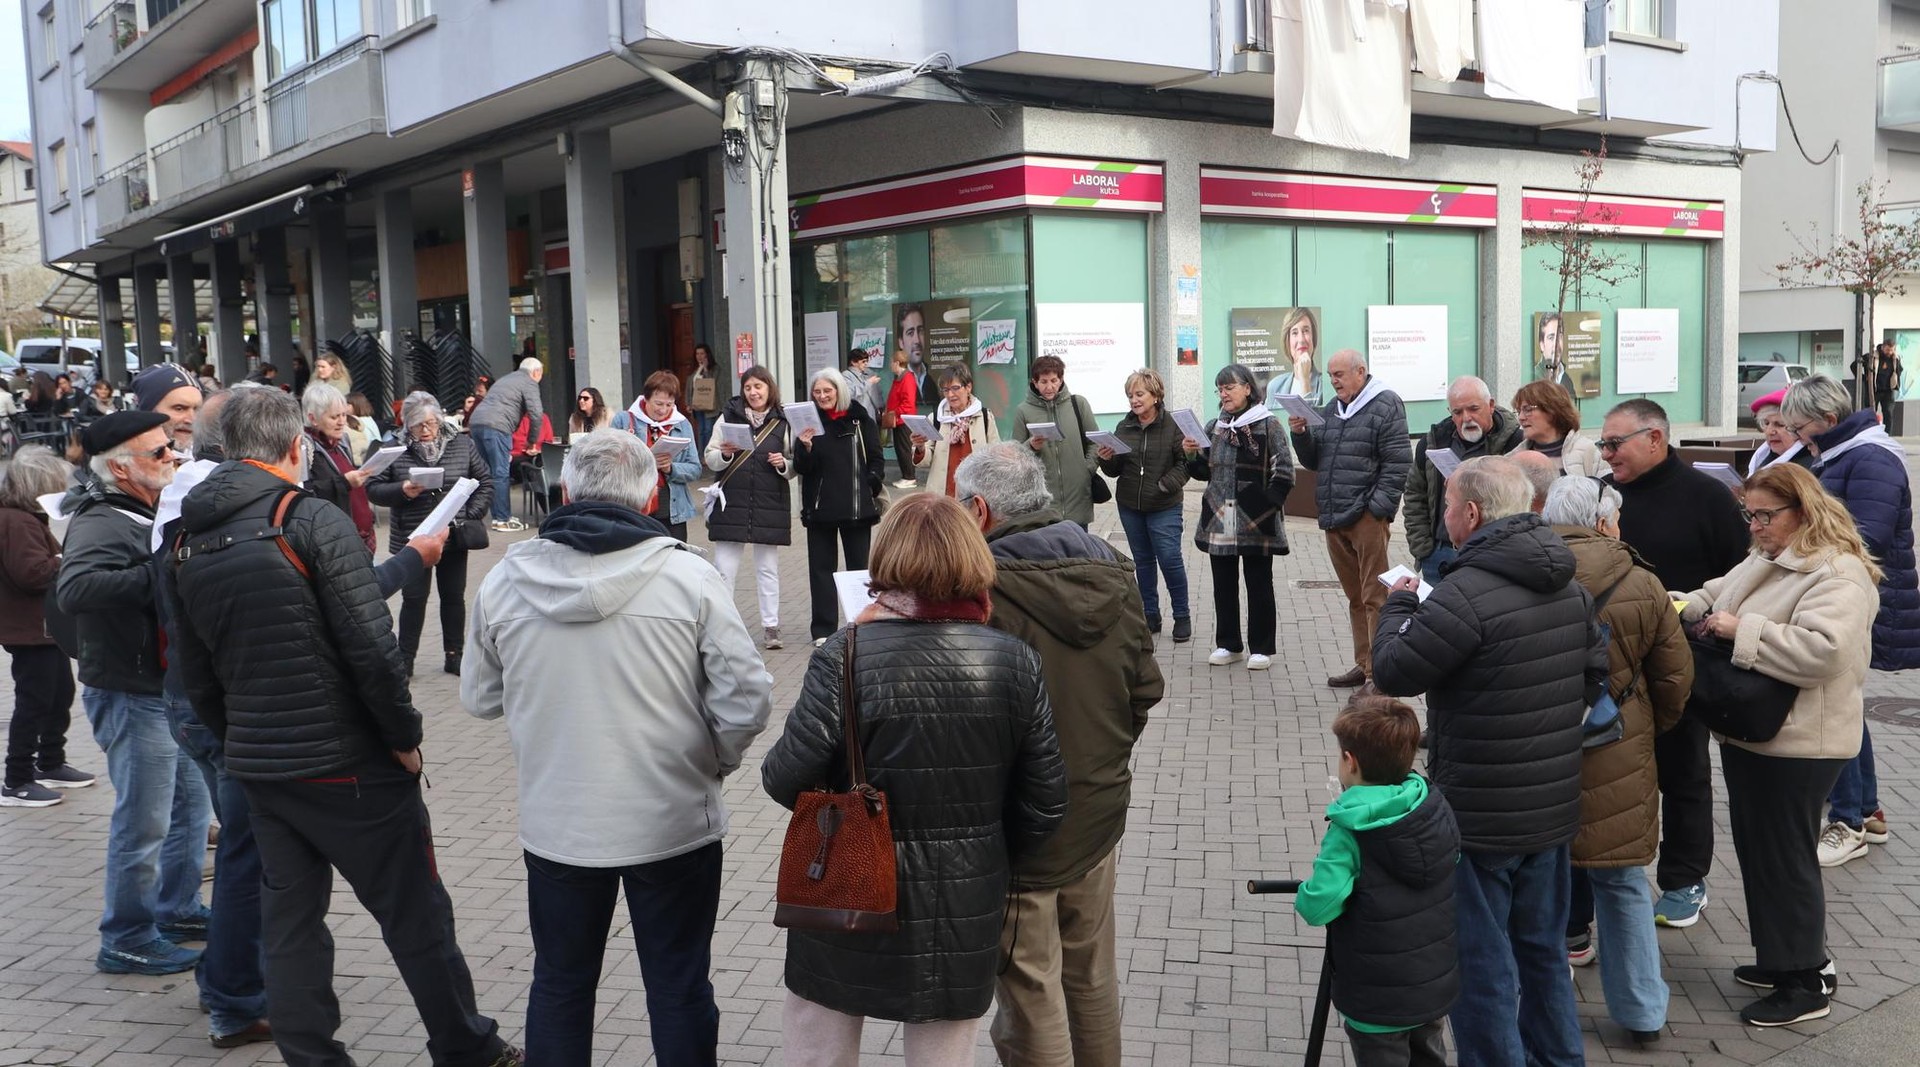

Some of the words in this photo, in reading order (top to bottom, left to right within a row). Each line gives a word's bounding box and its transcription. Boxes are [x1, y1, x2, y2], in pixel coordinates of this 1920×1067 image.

[1073, 174, 1119, 187] LABORAL
[1100, 187, 1119, 195] kutxa
[1673, 209, 1699, 220] LABORAL
[1043, 339, 1068, 347] BIZIARO
